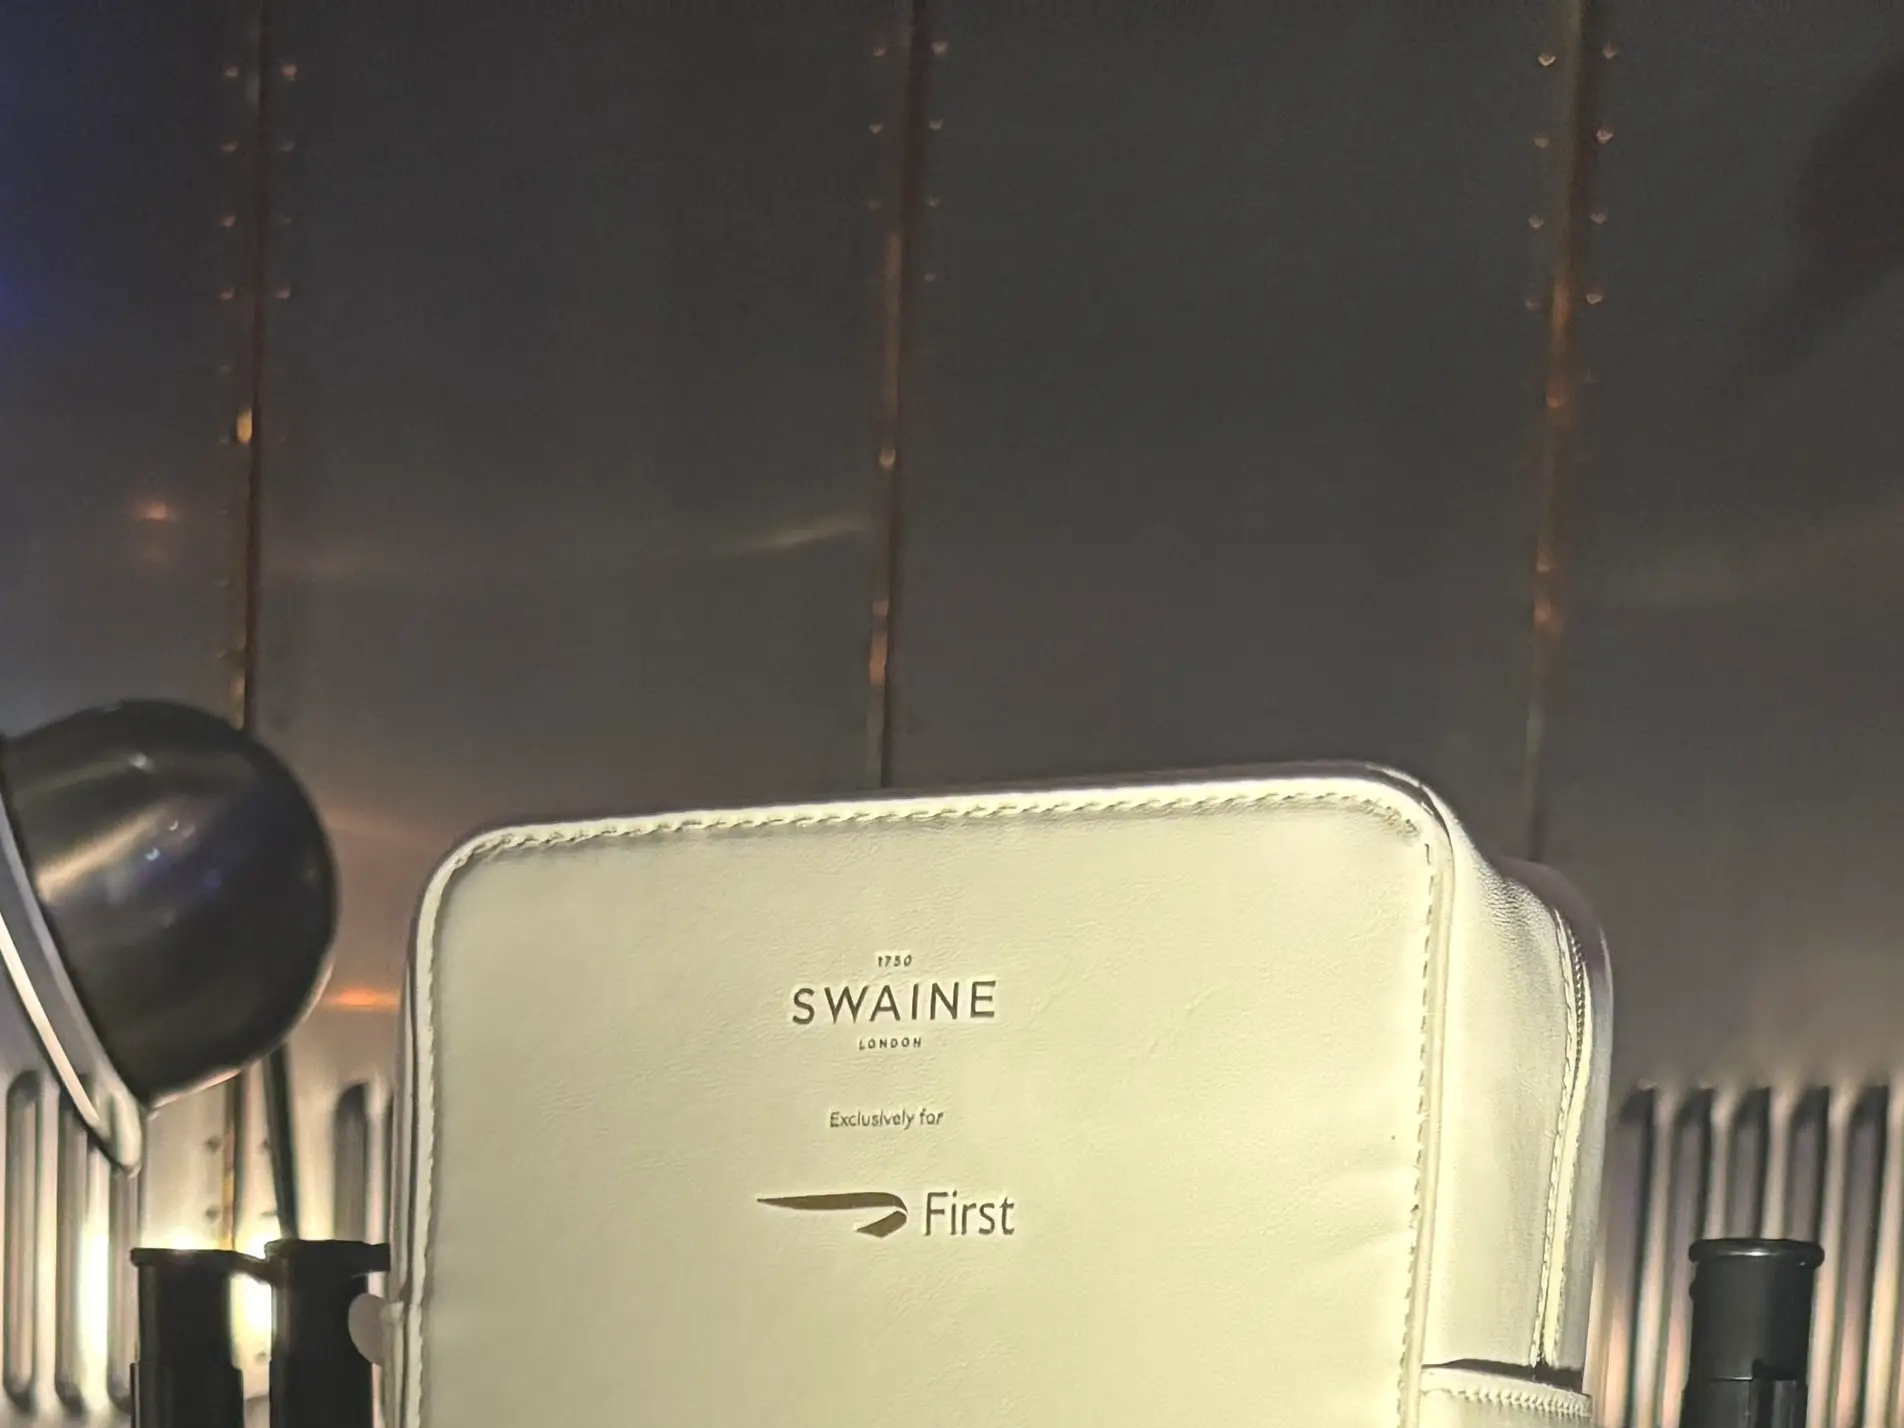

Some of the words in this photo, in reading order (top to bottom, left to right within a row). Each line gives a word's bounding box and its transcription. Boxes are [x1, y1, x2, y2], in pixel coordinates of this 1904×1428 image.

[878, 954, 913, 967] 1750
[792, 980, 997, 1025] SWAINE
[858, 1037, 922, 1051] LONDON
[829, 1109, 915, 1131] Exclusively
[919, 1108, 944, 1126] for
[923, 1189, 1016, 1237] First
